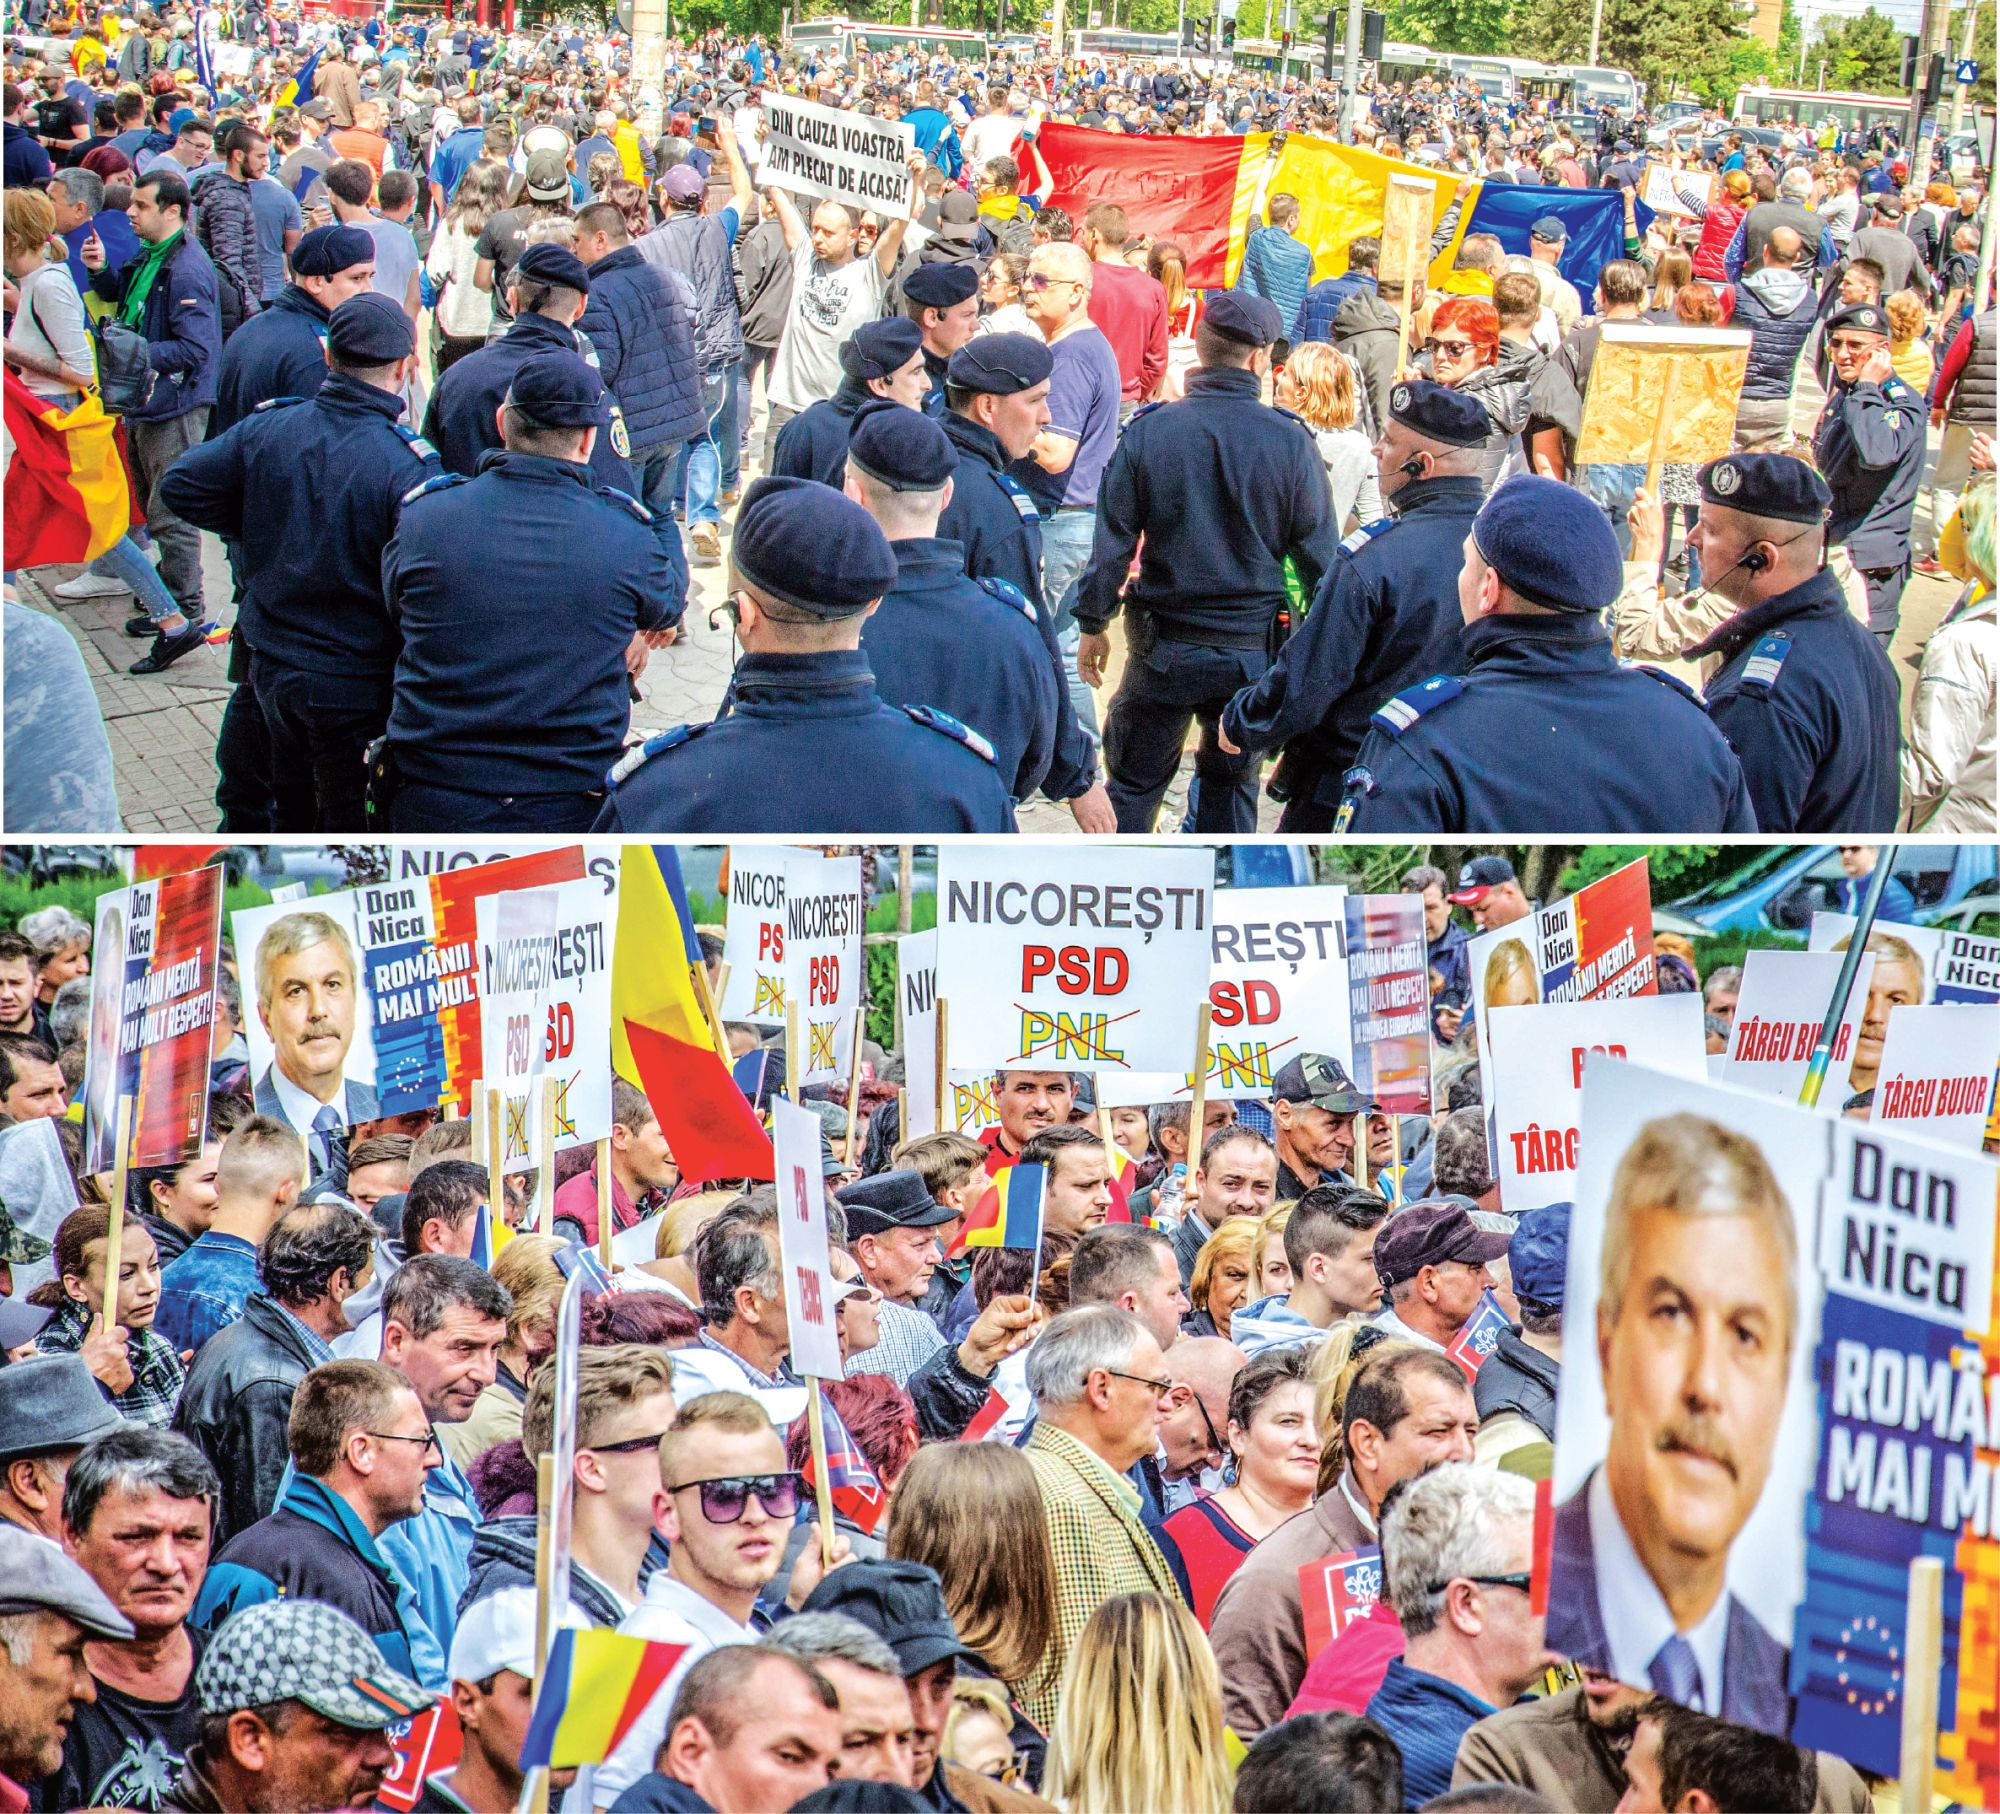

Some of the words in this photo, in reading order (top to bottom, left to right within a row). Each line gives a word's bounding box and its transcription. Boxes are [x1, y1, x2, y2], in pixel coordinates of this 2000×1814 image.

[772, 108, 793, 137] DIN
[797, 115, 838, 150] CAUZA
[767, 145, 789, 172] AM
[792, 151, 834, 187] PLECAT
[838, 165, 855, 193] DE
[131, 889, 151, 919] Dan
[365, 887, 416, 915] Dan
[733, 870, 784, 910] NICOR
[948, 879, 1205, 945] NICOREȘTI
[128, 923, 151, 957] Nica
[367, 915, 425, 946] Nica
[759, 921, 784, 964] PS
[788, 893, 860, 950] NICOREȘTI
[1210, 919, 1348, 975] REȘTI
[1542, 909, 1569, 940] Dan
[374, 941, 472, 993] ROMÂNII
[493, 937, 556, 1009] NICOREȘTI
[809, 955, 840, 1007] PSD
[1022, 944, 1130, 996] PSD
[1543, 940, 1574, 970] Nica
[1597, 926, 1637, 986] MERITĂ
[124, 965, 164, 1017] ROMÂNII
[164, 946, 202, 1001] MERITĂ
[377, 986, 424, 1025] MAI
[754, 975, 785, 1018] PN
[1208, 979, 1282, 1027] SD
[1391, 974, 1425, 1009] RESPECT
[120, 1018, 140, 1056] MAI
[138, 1008, 168, 1048] MULT
[167, 990, 212, 1040] RESPECT!
[506, 1014, 531, 1077] PSD
[545, 1001, 575, 1062] SD
[809, 1020, 837, 1073] PNL
[1020, 1011, 1125, 1062] PNL
[1734, 1015, 1796, 1062] TÂRGU
[1792, 1022, 1852, 1063] BUR
[1881, 1073, 1937, 1119] TÂRGU
[1935, 1076, 1988, 1116] BUJOR
[1510, 1123, 1581, 1175] TÂRG
[1852, 1137, 1956, 1229] Dan
[1843, 1214, 1966, 1314] Nica
[1831, 1337, 2000, 1453] ROMÂ
[1826, 1424, 1934, 1525] MAI
